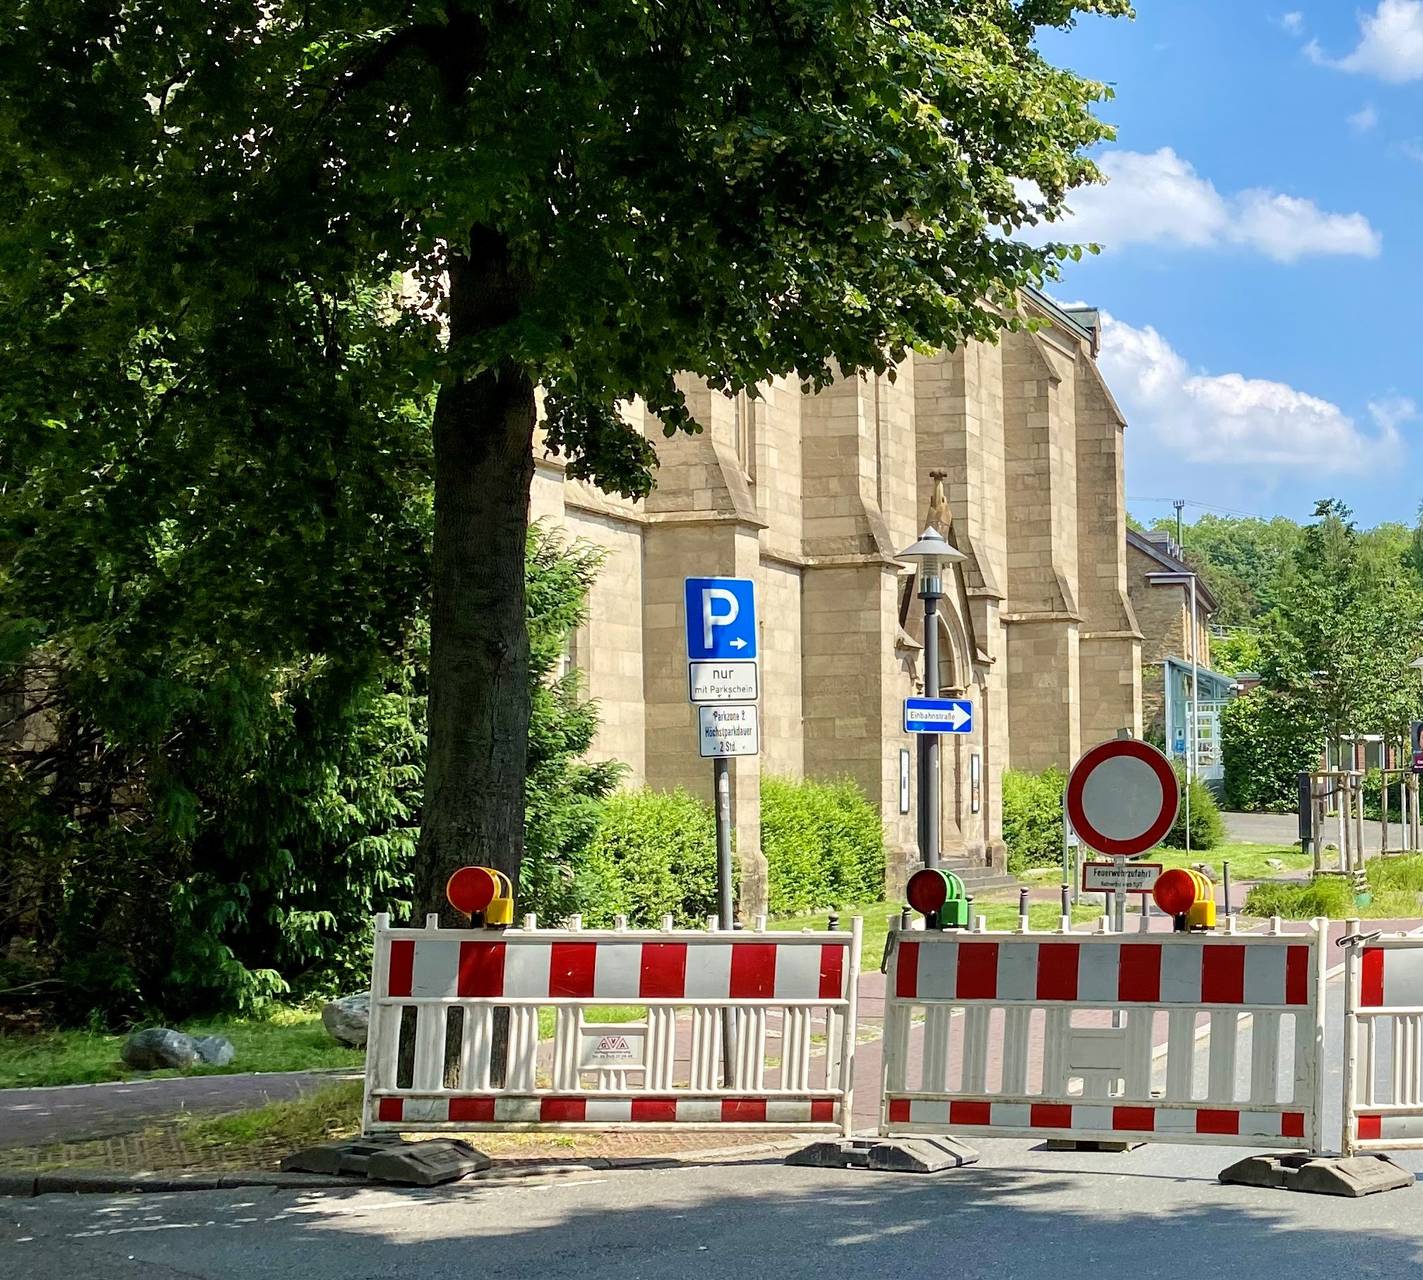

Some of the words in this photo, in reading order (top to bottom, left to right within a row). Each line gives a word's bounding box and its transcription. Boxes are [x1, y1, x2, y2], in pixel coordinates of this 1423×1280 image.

[702, 588, 740, 649] P
[712, 669, 734, 680] nur
[694, 685, 708, 694] mit
[710, 684, 753, 694] Parkschein
[713, 710, 740, 721] Parkzone
[910, 710, 956, 720] Einbahnstraße
[704, 725, 752, 739] Höchstparkdauer
[720, 741, 724, 752] 2
